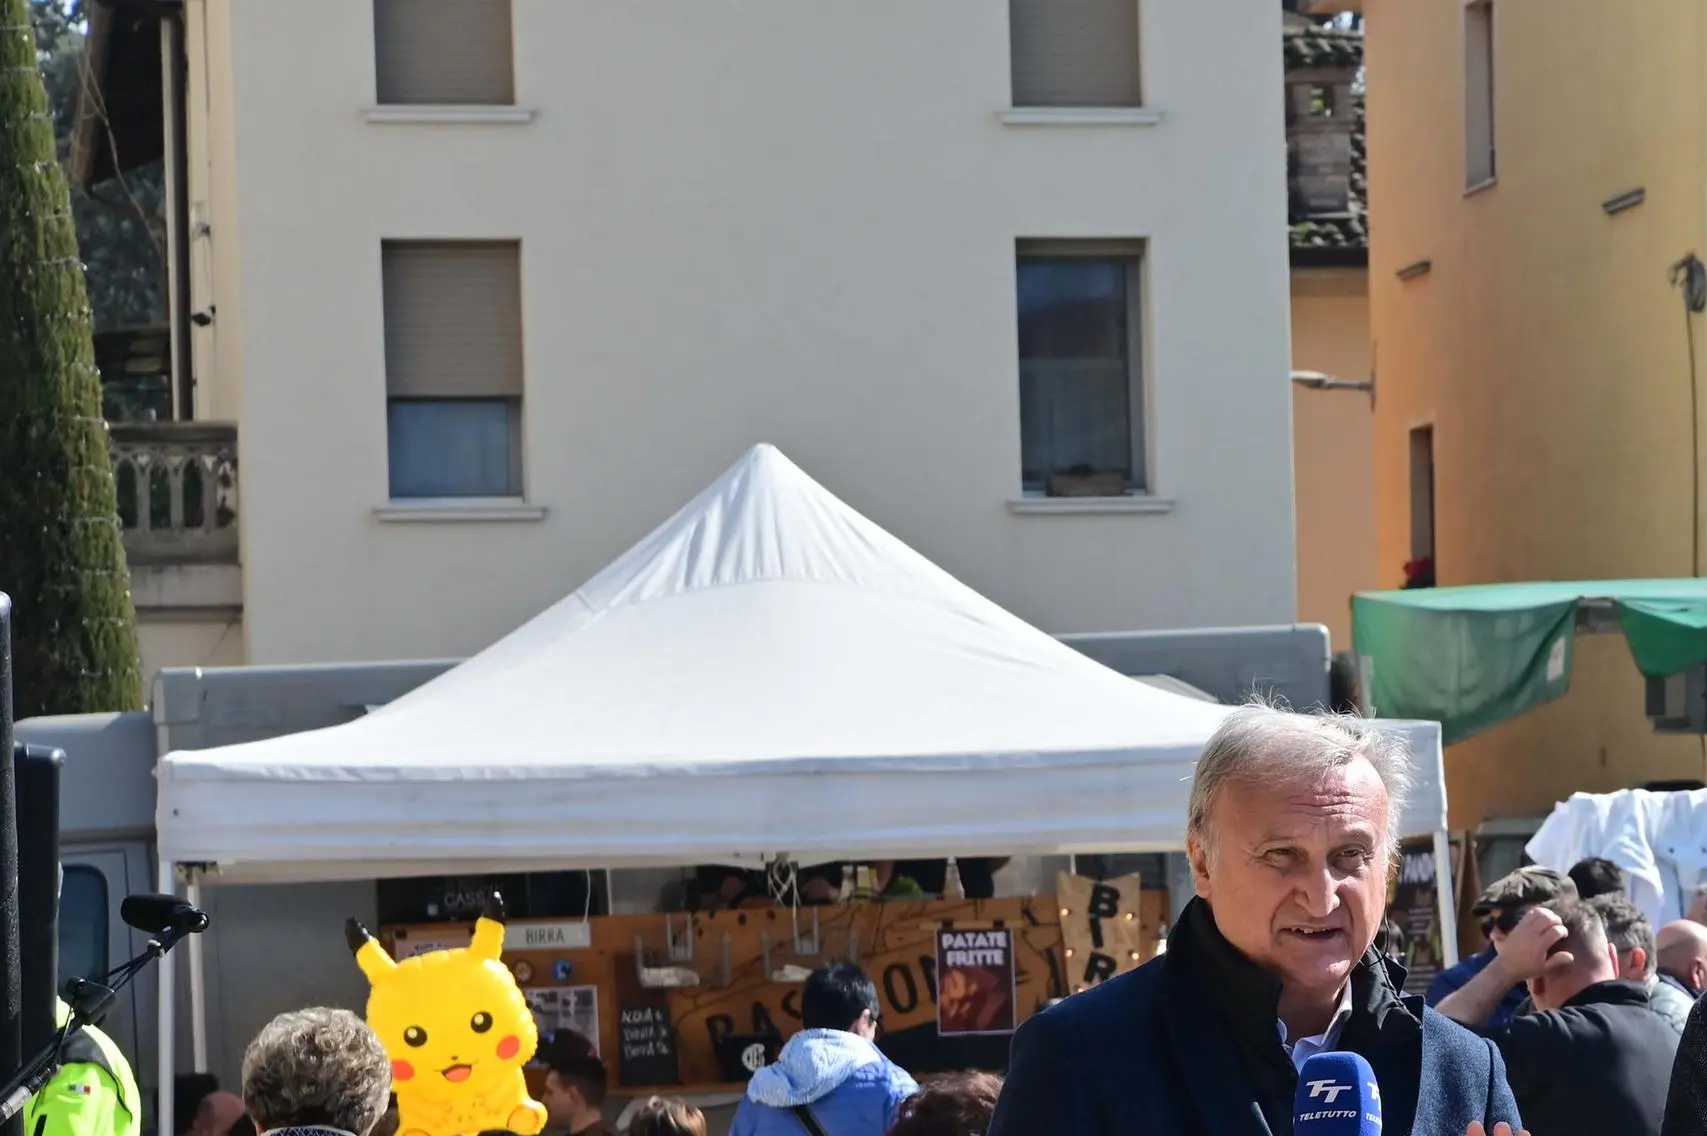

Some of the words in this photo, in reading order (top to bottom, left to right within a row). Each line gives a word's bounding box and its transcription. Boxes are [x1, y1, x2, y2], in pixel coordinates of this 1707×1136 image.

[444, 891, 489, 907] CASS
[525, 928, 565, 944] BIRRA
[941, 931, 1008, 949] PATATE
[946, 949, 1005, 967] FRITTE
[1300, 1110, 1357, 1122] TELETUTTO
